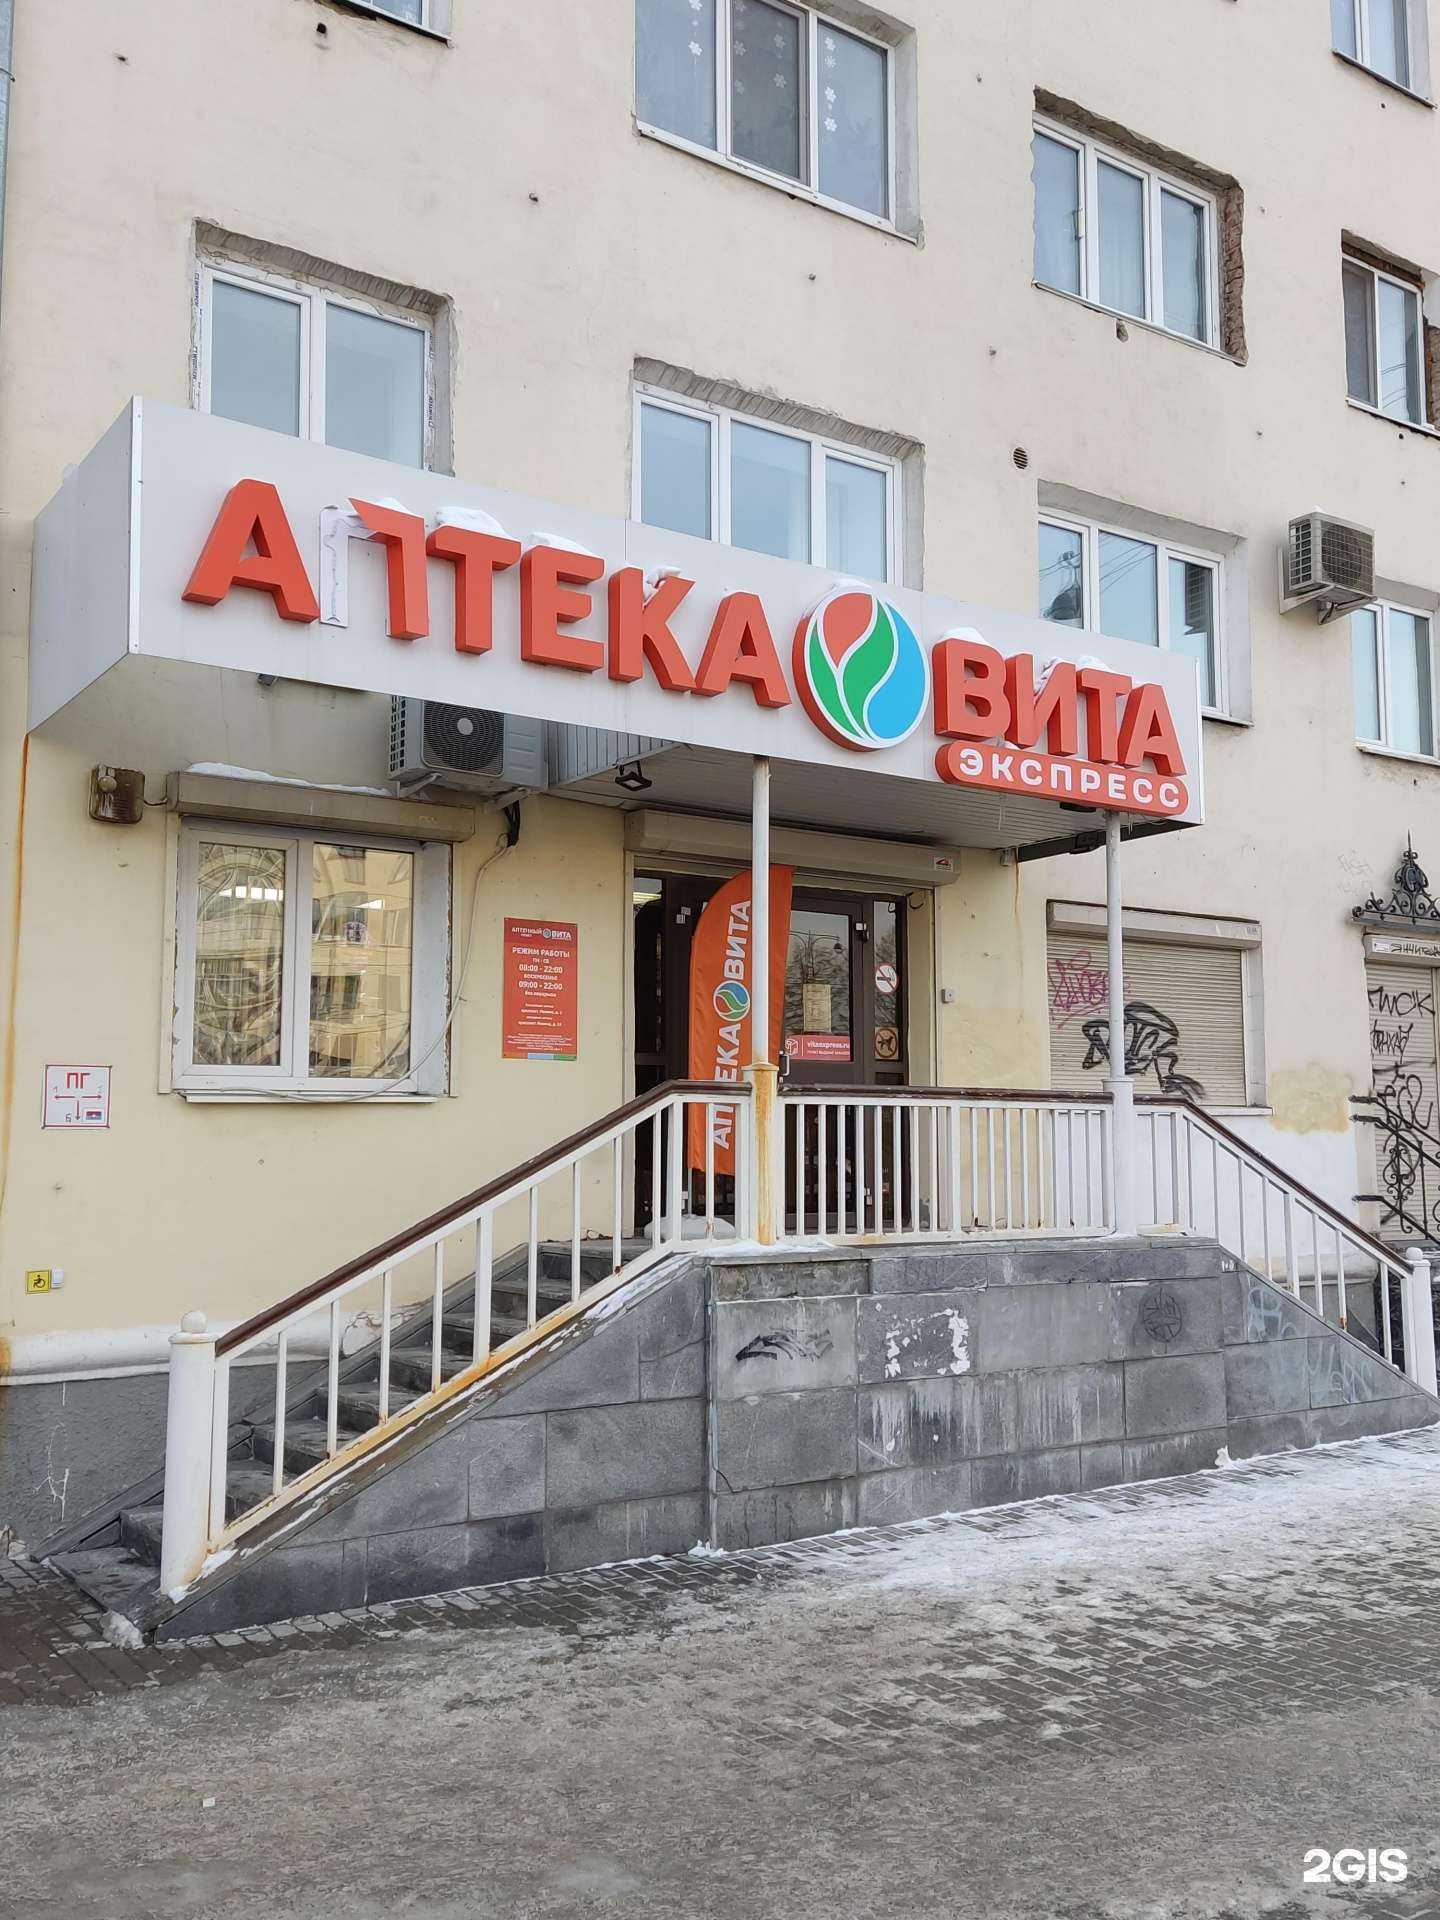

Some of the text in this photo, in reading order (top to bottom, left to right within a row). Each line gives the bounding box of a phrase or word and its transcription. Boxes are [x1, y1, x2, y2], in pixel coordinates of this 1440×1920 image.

[181, 478, 1187, 777] АПТЕКА ВИТА
[959, 748, 1181, 808] ЭКСПРЕСС
[551, 930, 571, 938] ВИТА
[512, 946, 570, 958] РЕЖИМ РАБОТЫ
[518, 963, 539, 972] 08:00
[543, 965, 563, 974] 22:00
[518, 980, 538, 988] 09:00
[543, 982, 563, 990] 22:00
[713, 899, 752, 1150] АПЕКА ВИТА
[66, 1072, 91, 1089] ПГ
